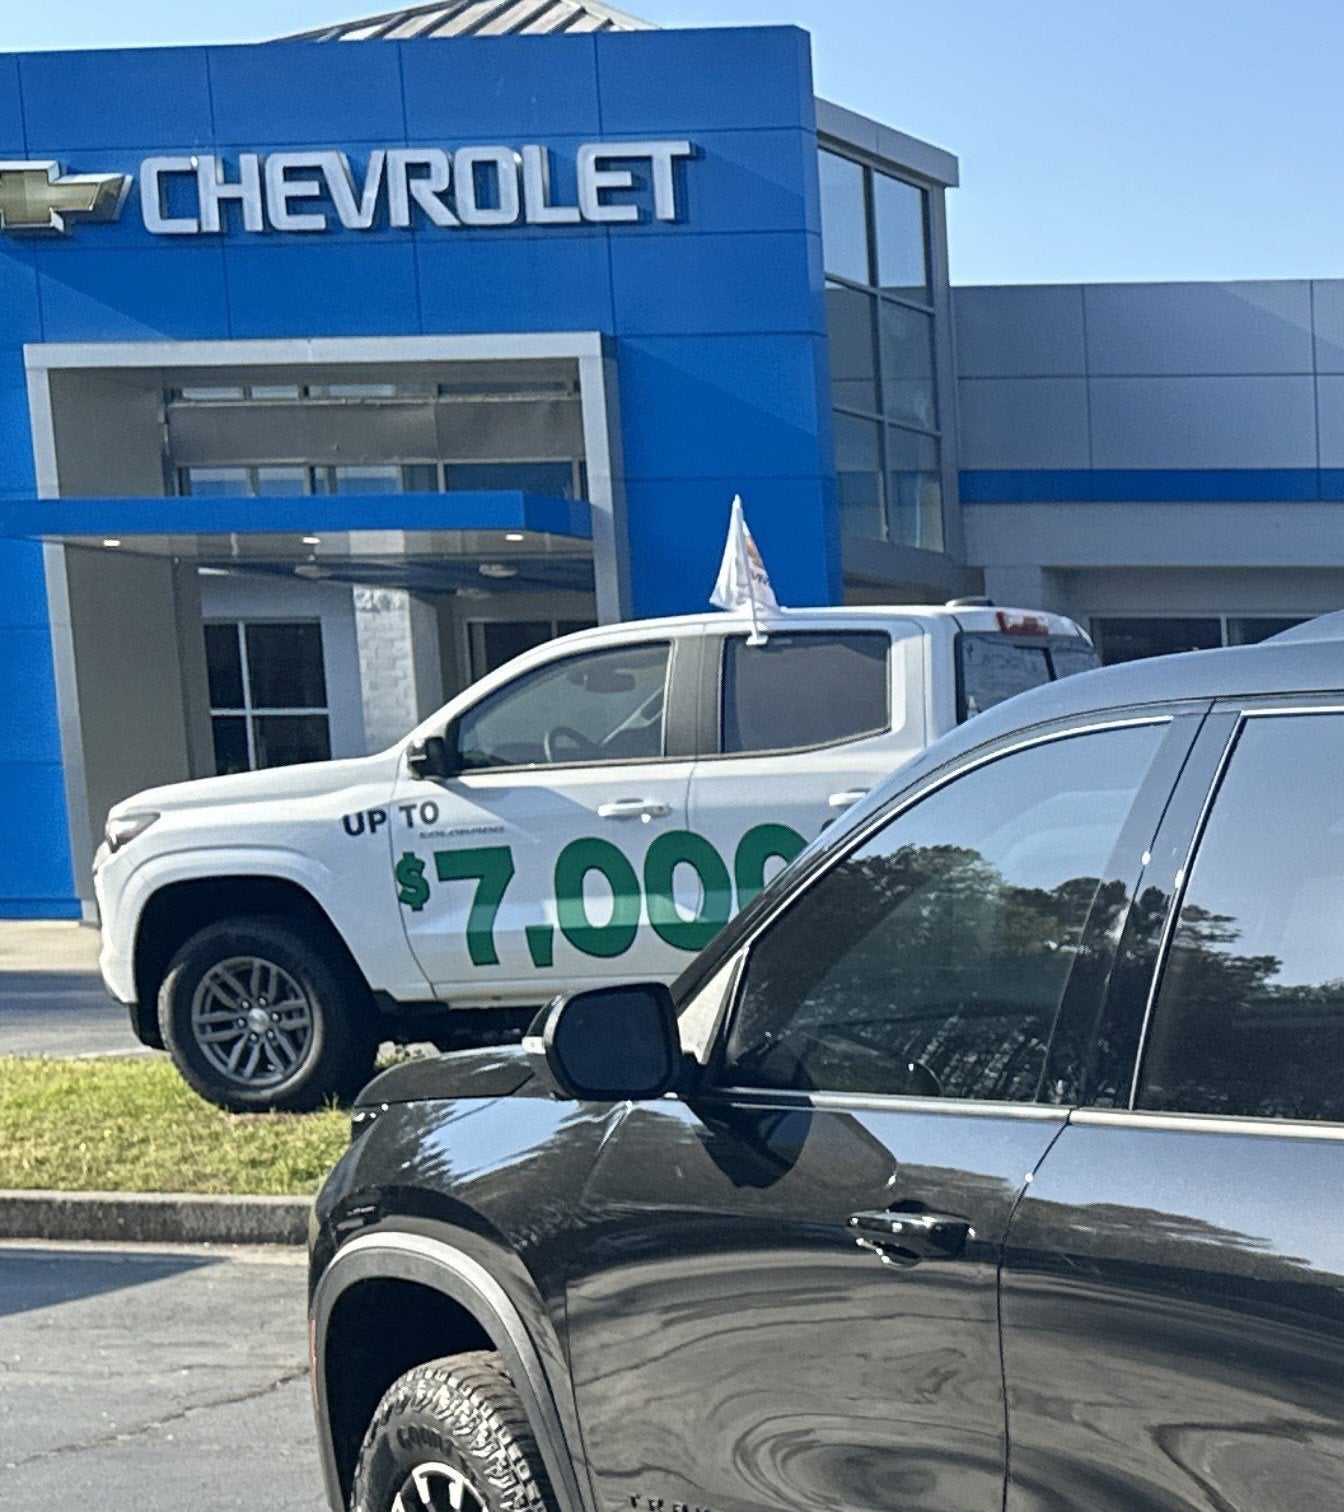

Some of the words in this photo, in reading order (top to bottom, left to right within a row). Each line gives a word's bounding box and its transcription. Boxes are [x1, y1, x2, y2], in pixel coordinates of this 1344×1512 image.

[139, 140, 693, 235] CHEVROLET
[342, 808, 388, 837] UP
[399, 801, 440, 828] TO
